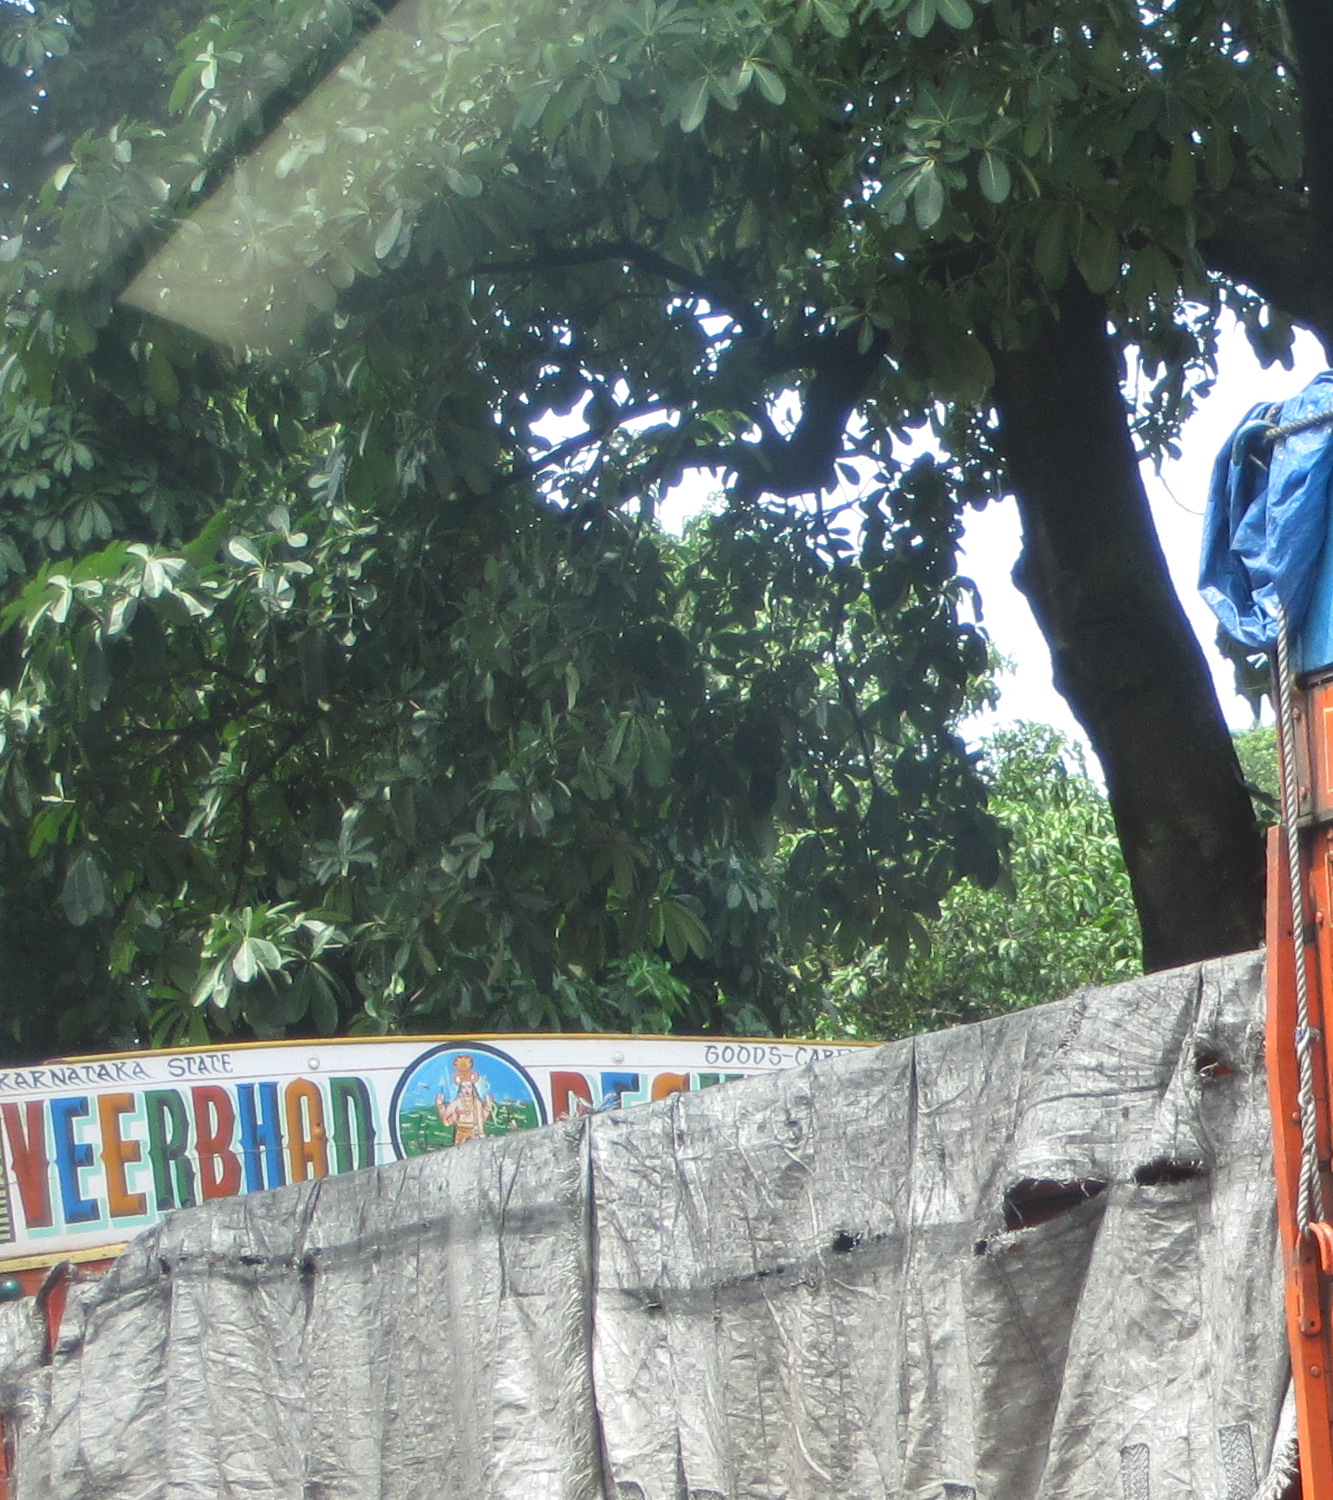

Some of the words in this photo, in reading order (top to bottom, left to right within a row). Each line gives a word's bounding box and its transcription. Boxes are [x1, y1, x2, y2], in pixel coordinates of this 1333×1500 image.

[0, 1061, 150, 1091] KARNATAKA
[169, 1053, 234, 1077] STATE
[2, 1076, 376, 1229] VEERBHAD
